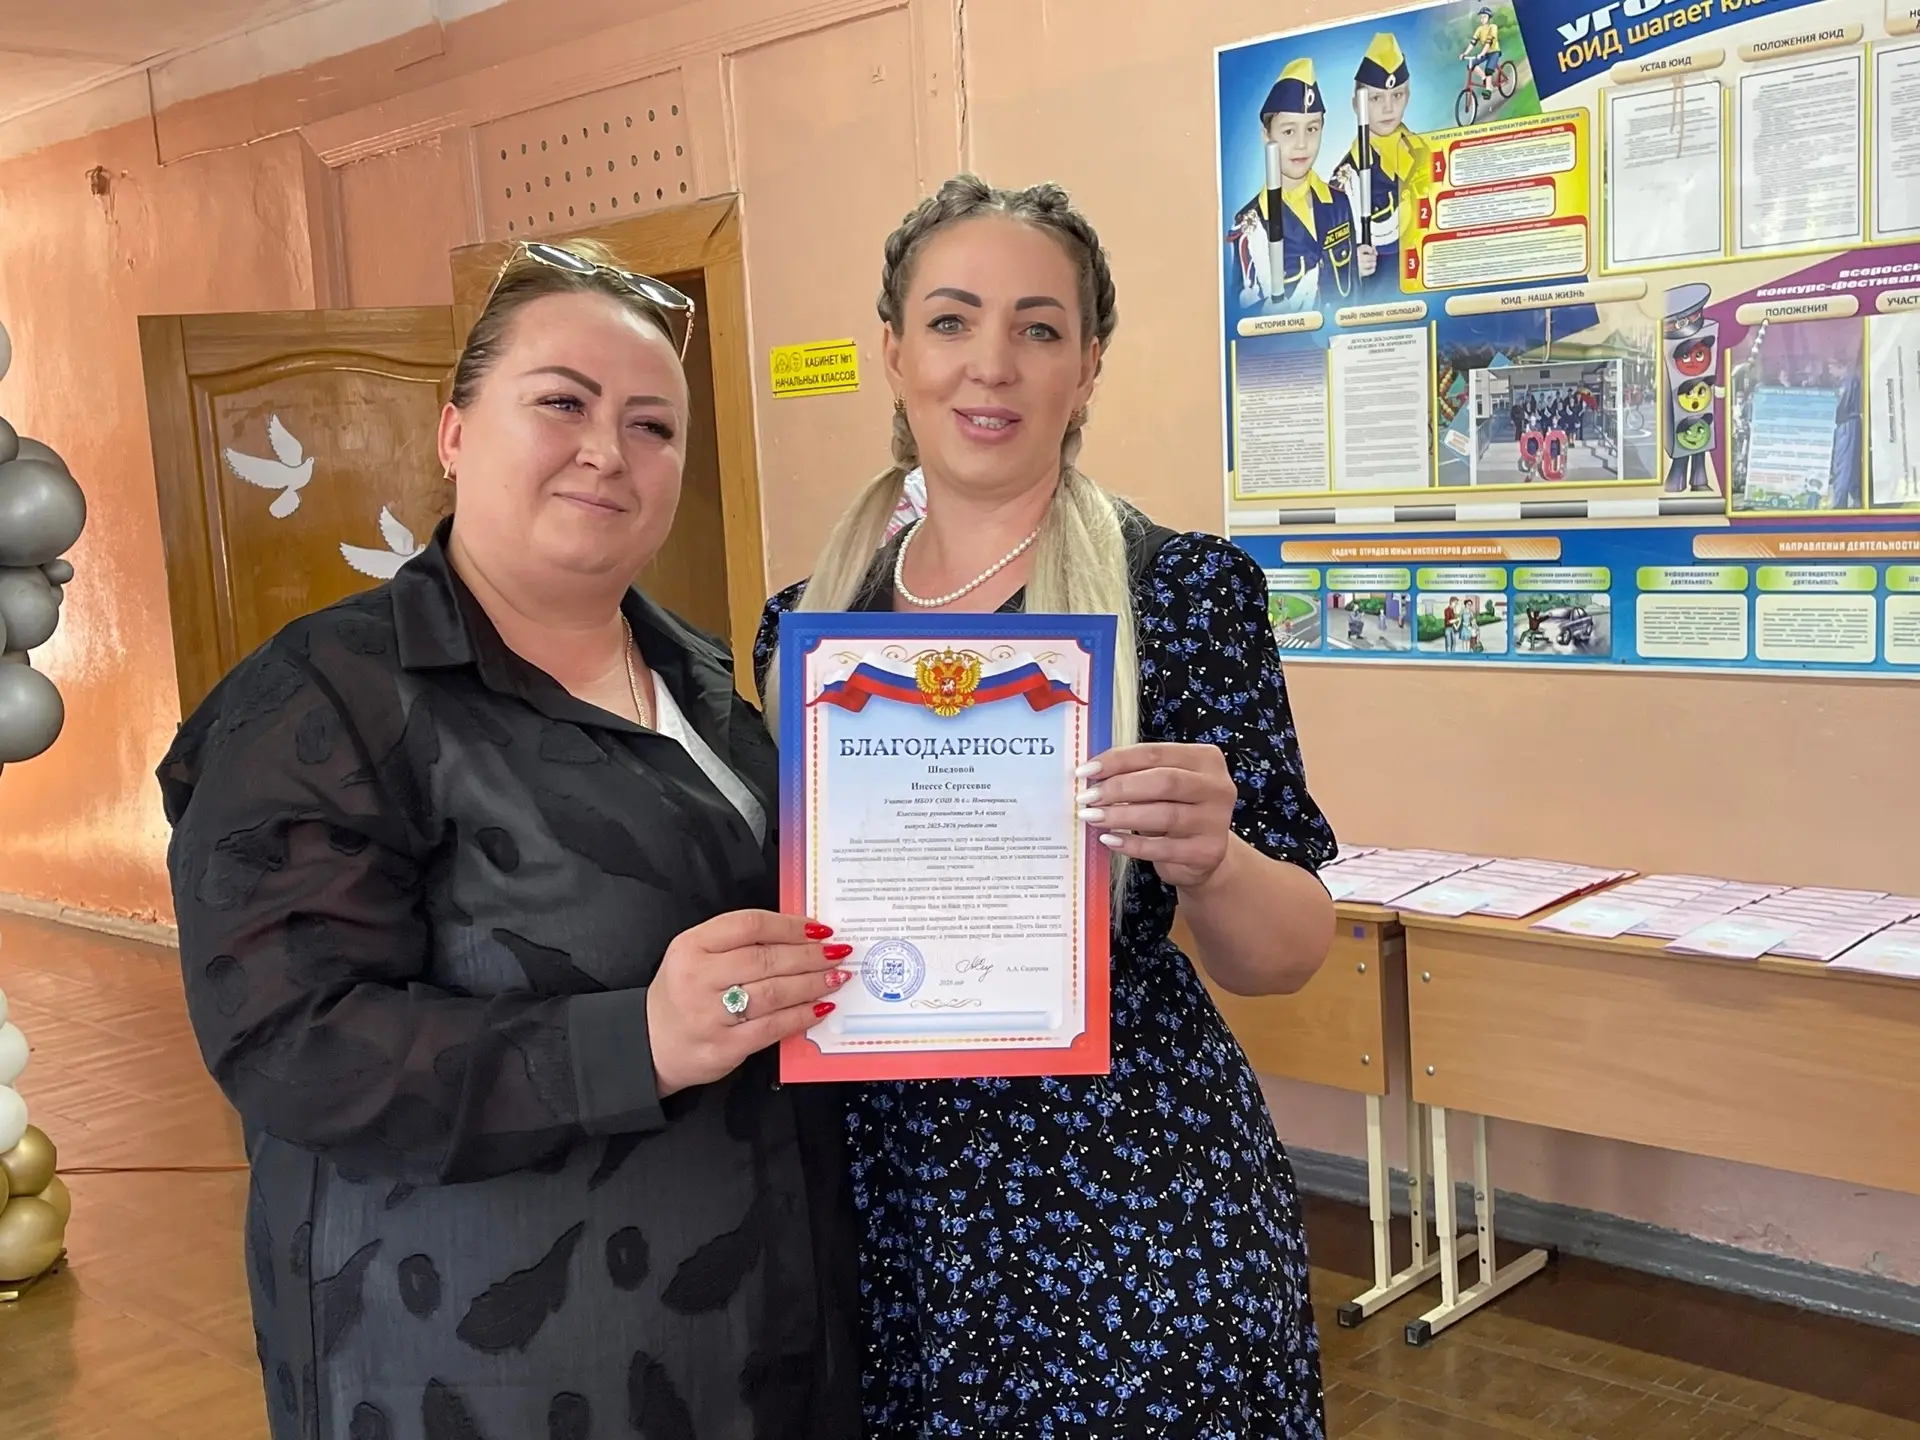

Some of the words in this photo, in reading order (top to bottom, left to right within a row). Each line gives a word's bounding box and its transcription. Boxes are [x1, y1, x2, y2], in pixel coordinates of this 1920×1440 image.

[1557, 0, 1677, 46] УГО
[1557, 28, 1623, 73] ЮИД
[1627, 0, 1713, 44] шагает
[1753, 33, 1816, 53] ПОЛОЖЕНИЯ
[1818, 28, 1845, 41] ЮИД
[1640, 60, 1667, 73] УСТАВ
[1668, 56, 1692, 69] ЮИД
[1434, 161, 1442, 173] 1
[1420, 207, 1428, 219] 2
[1408, 258, 1416, 269] 3
[1501, 296, 1521, 305] ЮИД
[1528, 293, 1554, 302] НАША
[1555, 290, 1585, 300] ЖИЗНЬ
[1765, 303, 1828, 316] ПОЛОЖЕНИЯ
[1254, 319, 1286, 330] ИСТОРИЯ
[1287, 317, 1305, 327] ЮИД
[804, 354, 839, 368] КАБИНЕТ
[775, 374, 820, 388] НАЧАЛЬНЫХ
[821, 370, 856, 383] КЛАССОВ
[1331, 547, 1357, 557] ЗАДАЧИ
[1359, 547, 1389, 557] ОТРЯДОВ
[1390, 547, 1412, 556] ЮНЫХ
[1413, 546, 1461, 556] ИНСПЕКТОРОВ
[1461, 546, 1502, 556] ДВИЖЕНИЯ
[1779, 541, 1846, 552] НАПРАВЛЕНИЯ
[1846, 540, 1920, 552] ДЕЯТЕЛЬНОСТИ
[839, 737, 1056, 760] БЛАГОДАРНОСТЬ
[911, 782, 943, 791] Инессе
[945, 781, 992, 792] Сергеевне
